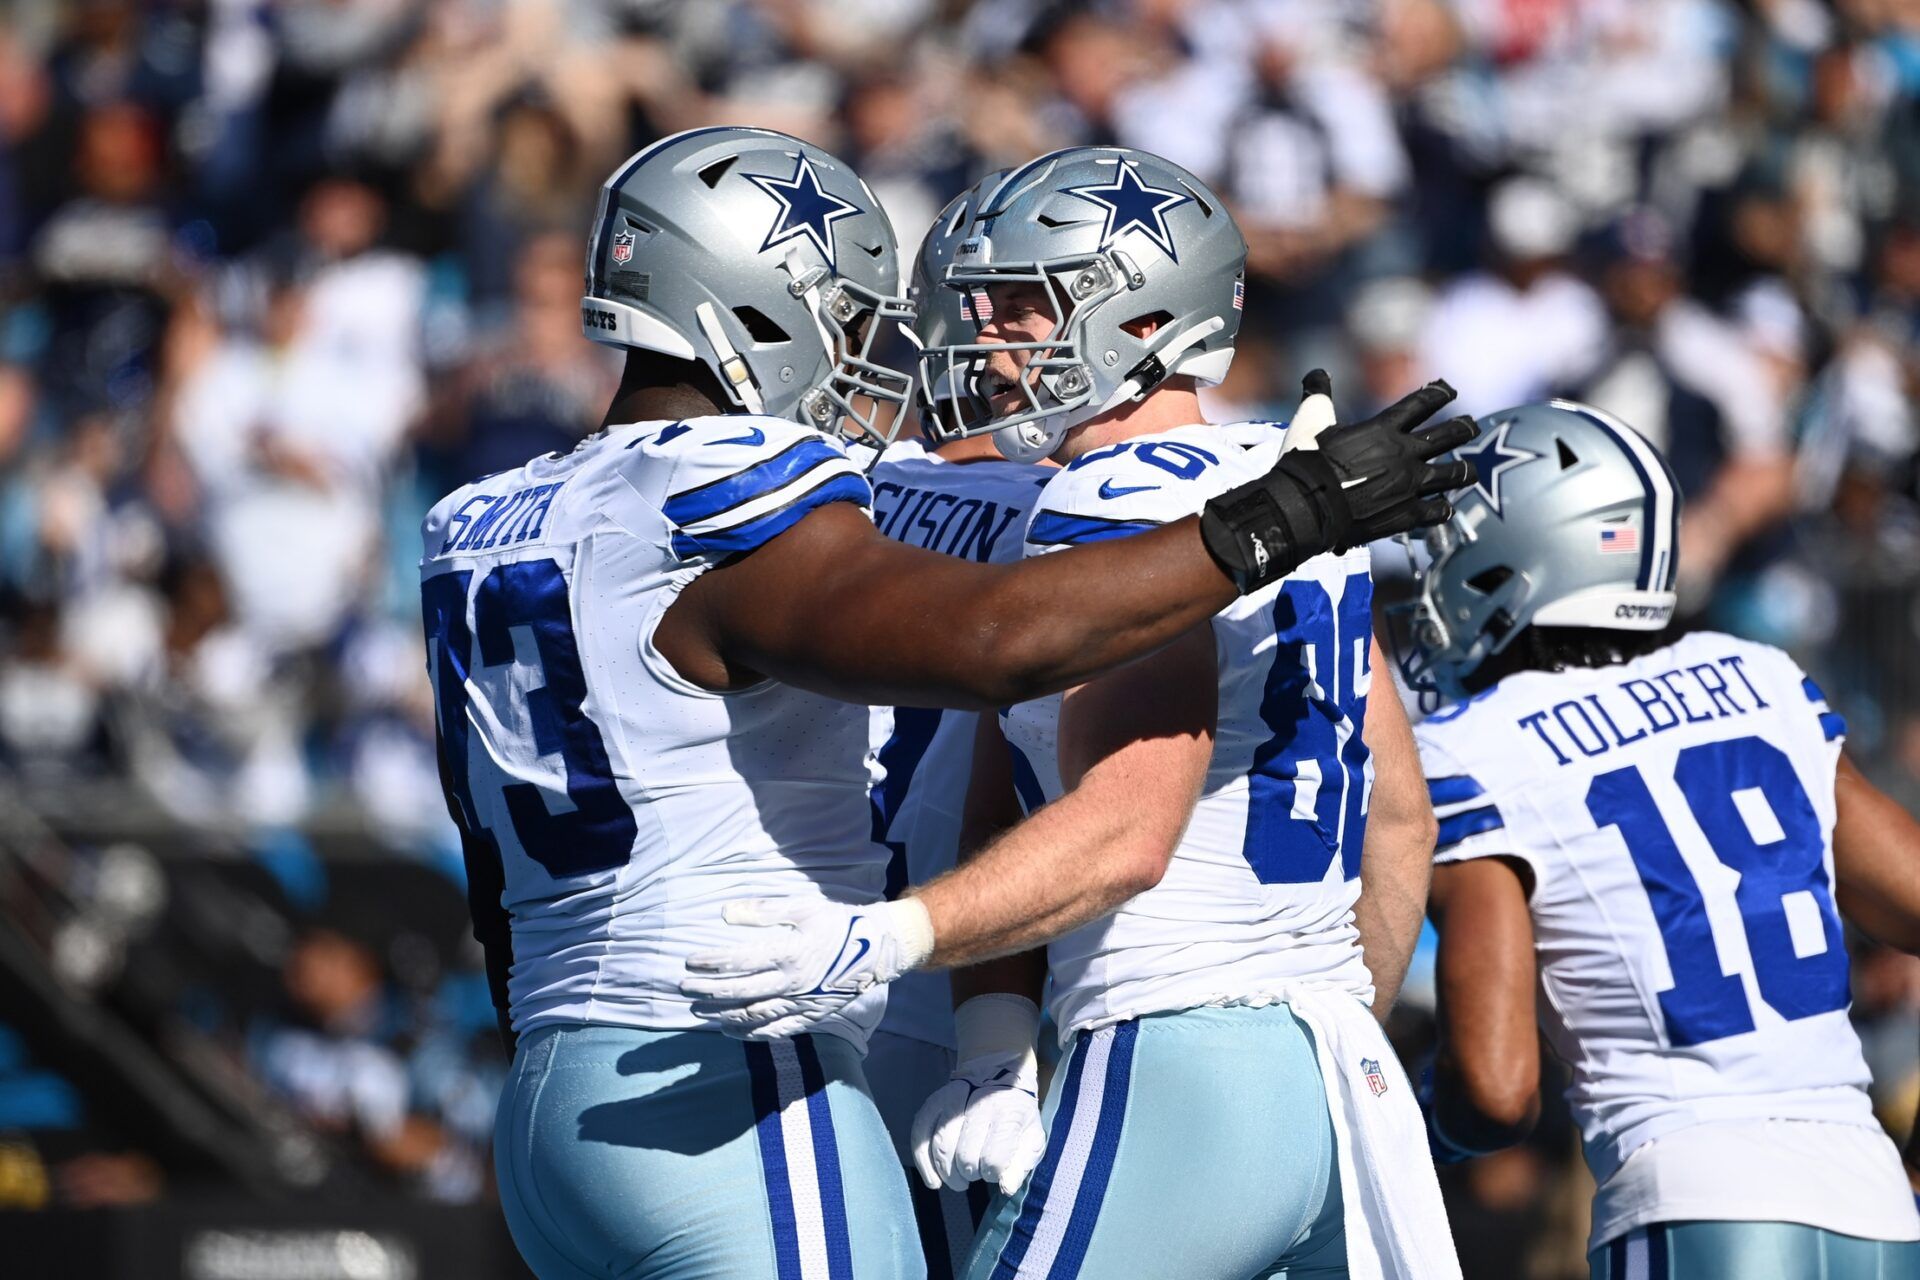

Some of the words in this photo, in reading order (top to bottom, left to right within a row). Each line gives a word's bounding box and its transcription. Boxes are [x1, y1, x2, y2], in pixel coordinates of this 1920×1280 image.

[614, 246, 630, 260] NFL
[441, 481, 565, 555] SMITH
[868, 477, 1022, 563] GUSON
[421, 558, 639, 880] 73
[1518, 656, 1770, 766] TOLBERT
[1585, 735, 1853, 1048] 18
